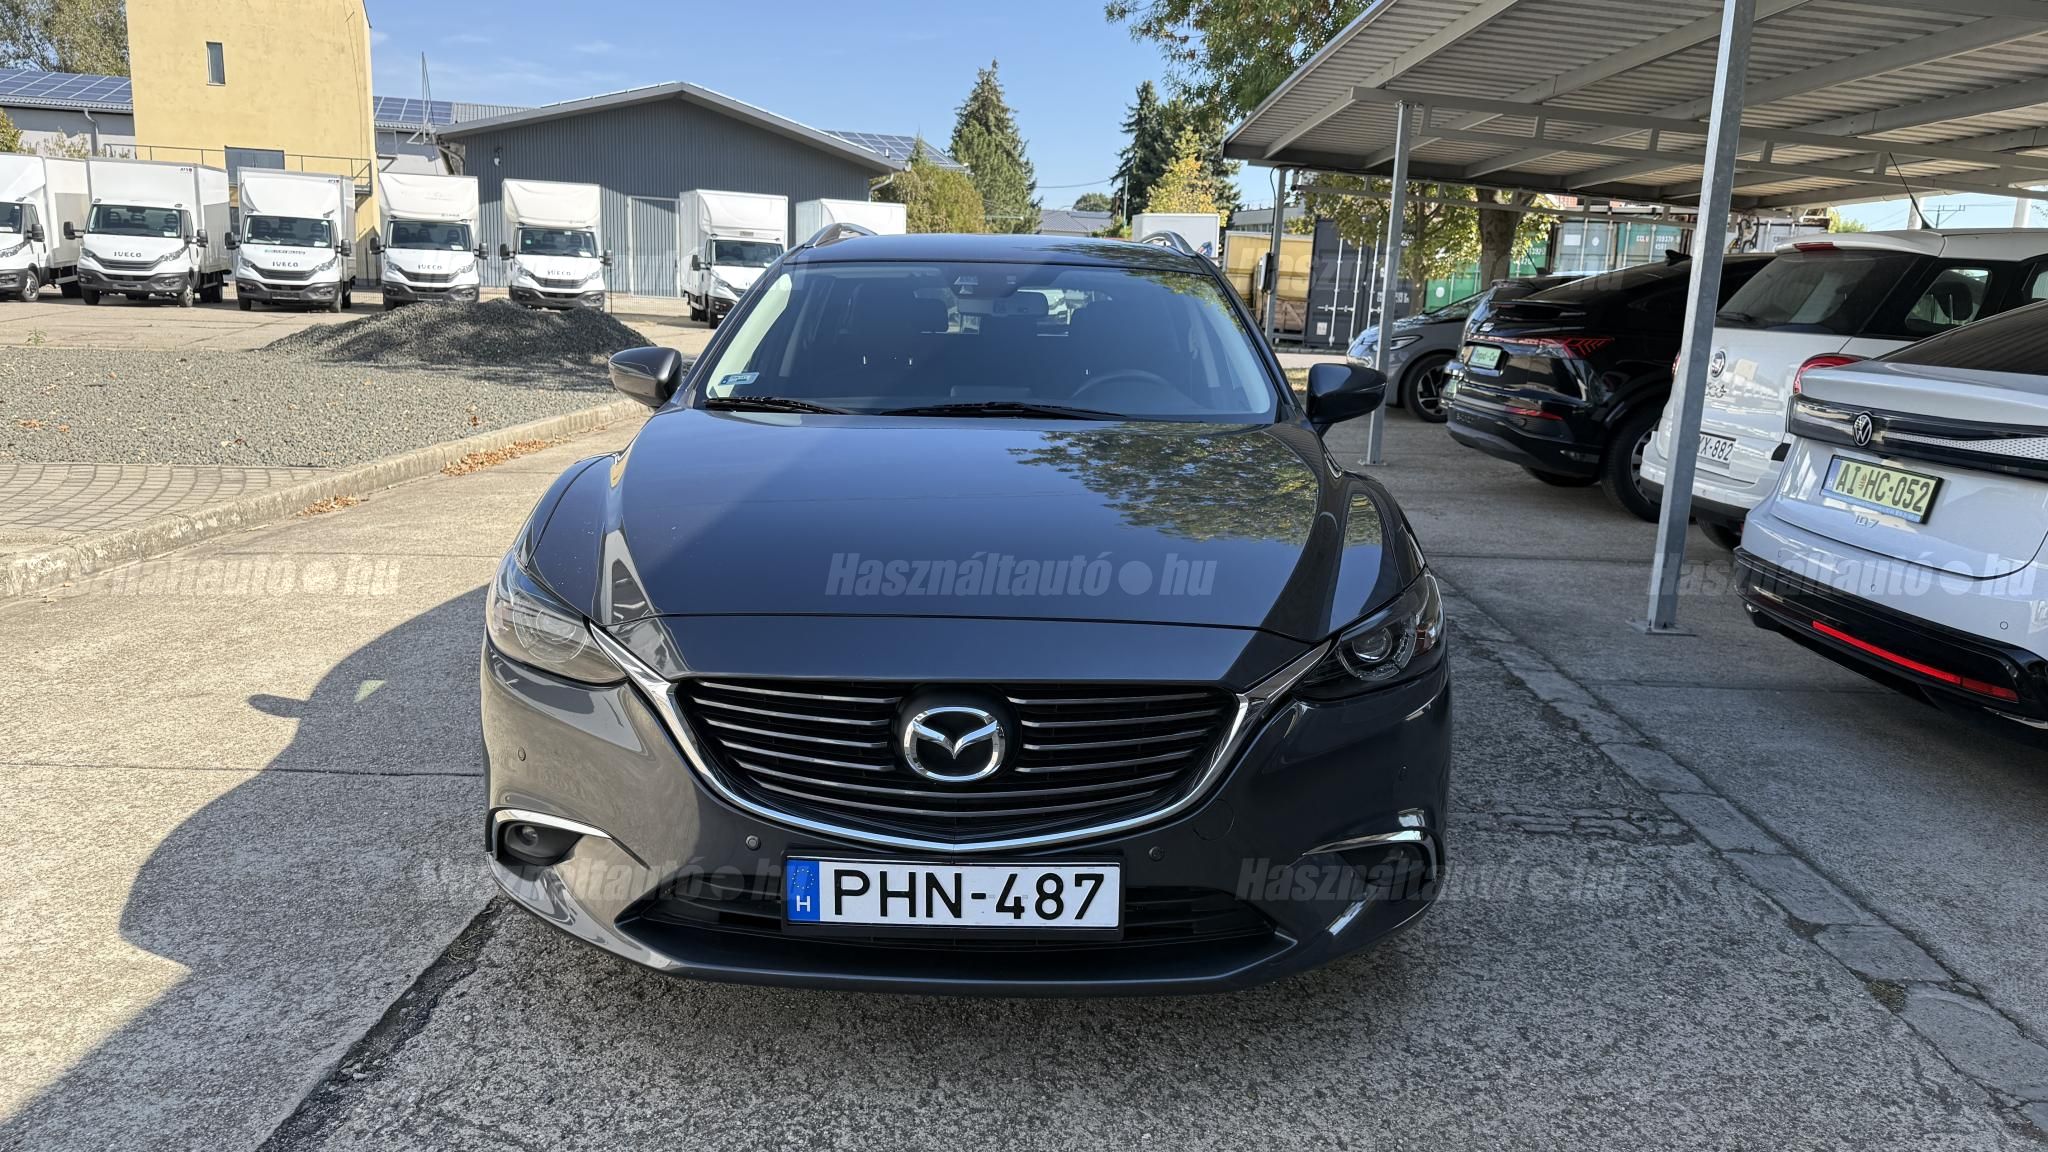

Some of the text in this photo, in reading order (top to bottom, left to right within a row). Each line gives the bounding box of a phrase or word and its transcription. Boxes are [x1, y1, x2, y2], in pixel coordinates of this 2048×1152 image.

[1836, 464, 1861, 495] AI
[1862, 469, 1930, 512] HC-052
[796, 868, 1105, 921] H PHN-487
